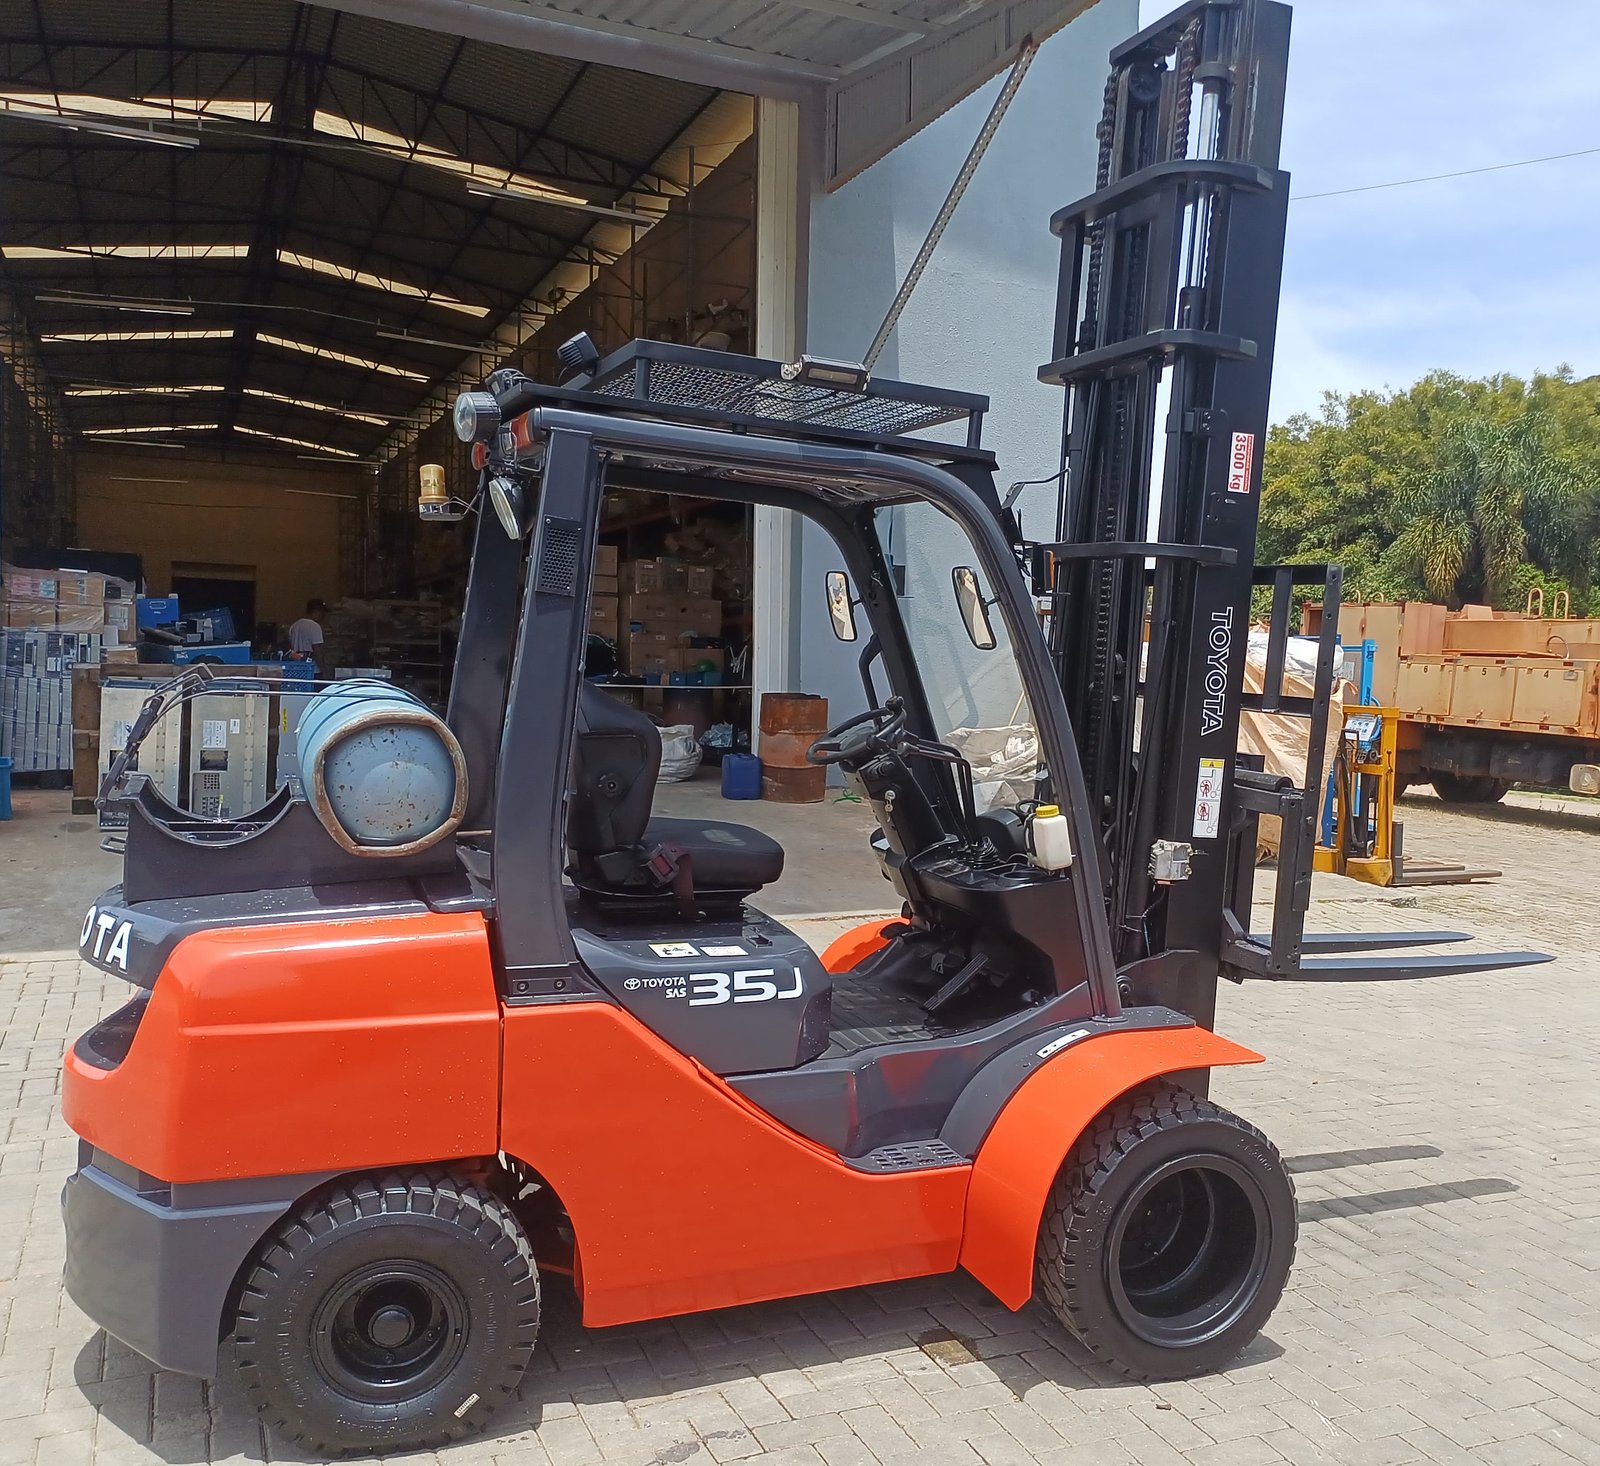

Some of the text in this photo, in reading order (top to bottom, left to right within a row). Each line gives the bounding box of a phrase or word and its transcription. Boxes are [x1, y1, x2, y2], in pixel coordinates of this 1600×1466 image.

[1229, 434, 1247, 490] 3500 kg
[1201, 606, 1234, 737] TOYOTA
[1423, 665, 1429, 674] 6
[1481, 667, 1487, 676] 5
[1543, 669, 1549, 679] 4
[641, 976, 687, 988] TOYOTA
[688, 966, 804, 1007] 35J
[665, 987, 687, 999] SAS
